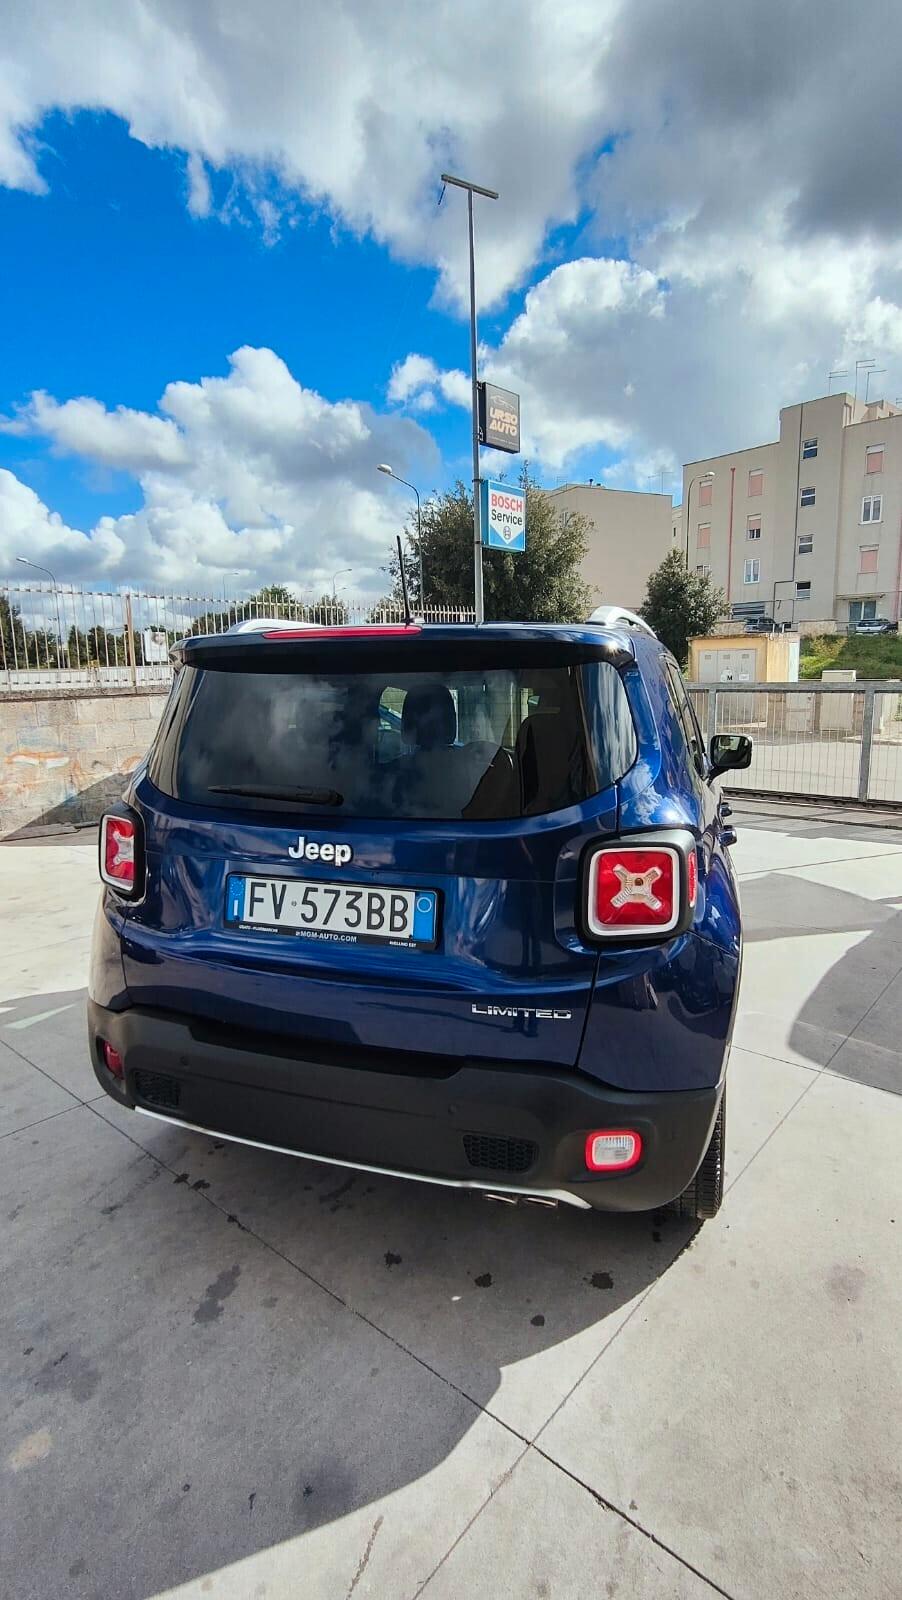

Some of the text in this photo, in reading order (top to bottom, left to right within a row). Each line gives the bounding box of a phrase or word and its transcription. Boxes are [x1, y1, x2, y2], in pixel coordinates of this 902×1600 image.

[490, 407, 518, 425] URSO
[489, 420, 518, 437] AUTO
[491, 493, 523, 512] BOSCH
[491, 510, 523, 526] Service
[288, 836, 352, 867] Jeep
[249, 882, 409, 933] FV 573BB
[471, 1003, 572, 1019] LIMITED
